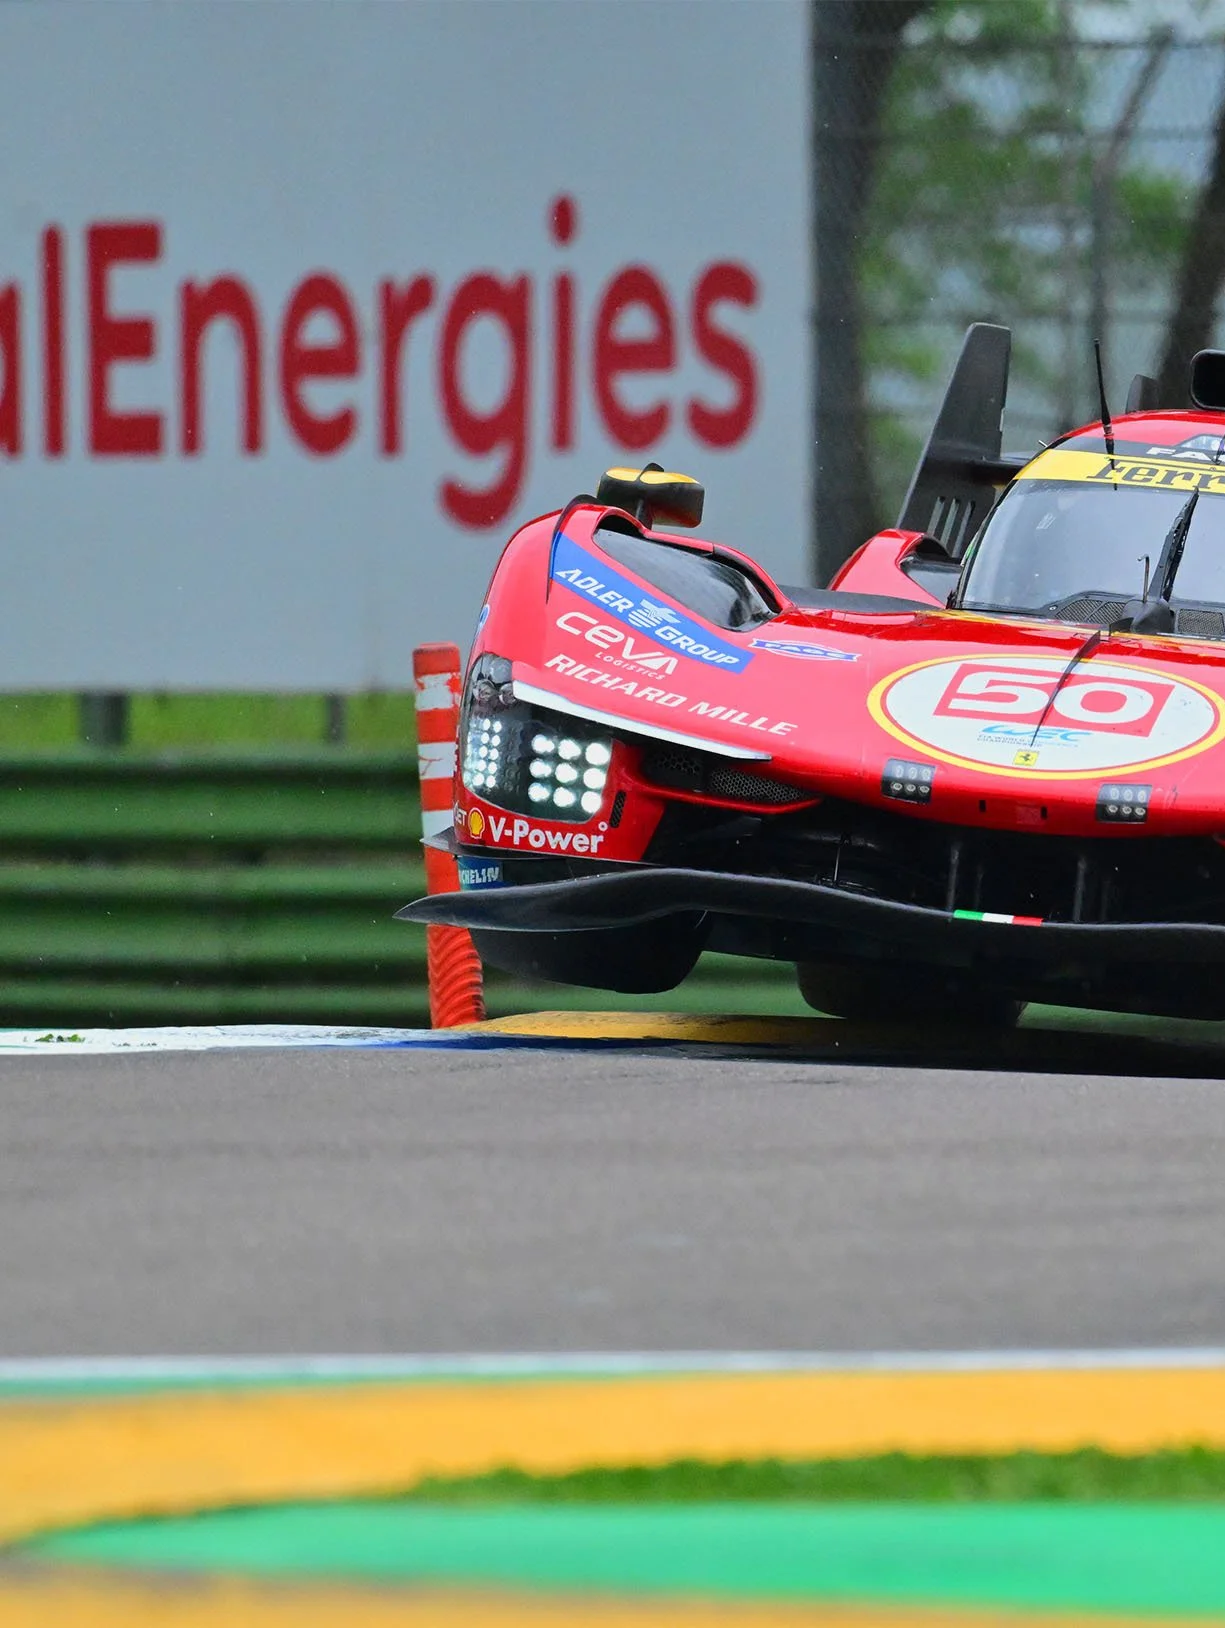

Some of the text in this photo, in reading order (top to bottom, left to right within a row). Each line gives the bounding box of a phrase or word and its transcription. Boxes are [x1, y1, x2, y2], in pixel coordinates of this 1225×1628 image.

[0, 193, 760, 529] lEnergies
[554, 568, 740, 666] ADLER GROUP
[544, 653, 799, 736] RICHARD MILLE
[594, 651, 666, 681] LOGISTICS
[947, 671, 1154, 724] 50
[488, 815, 605, 853] V-Power
